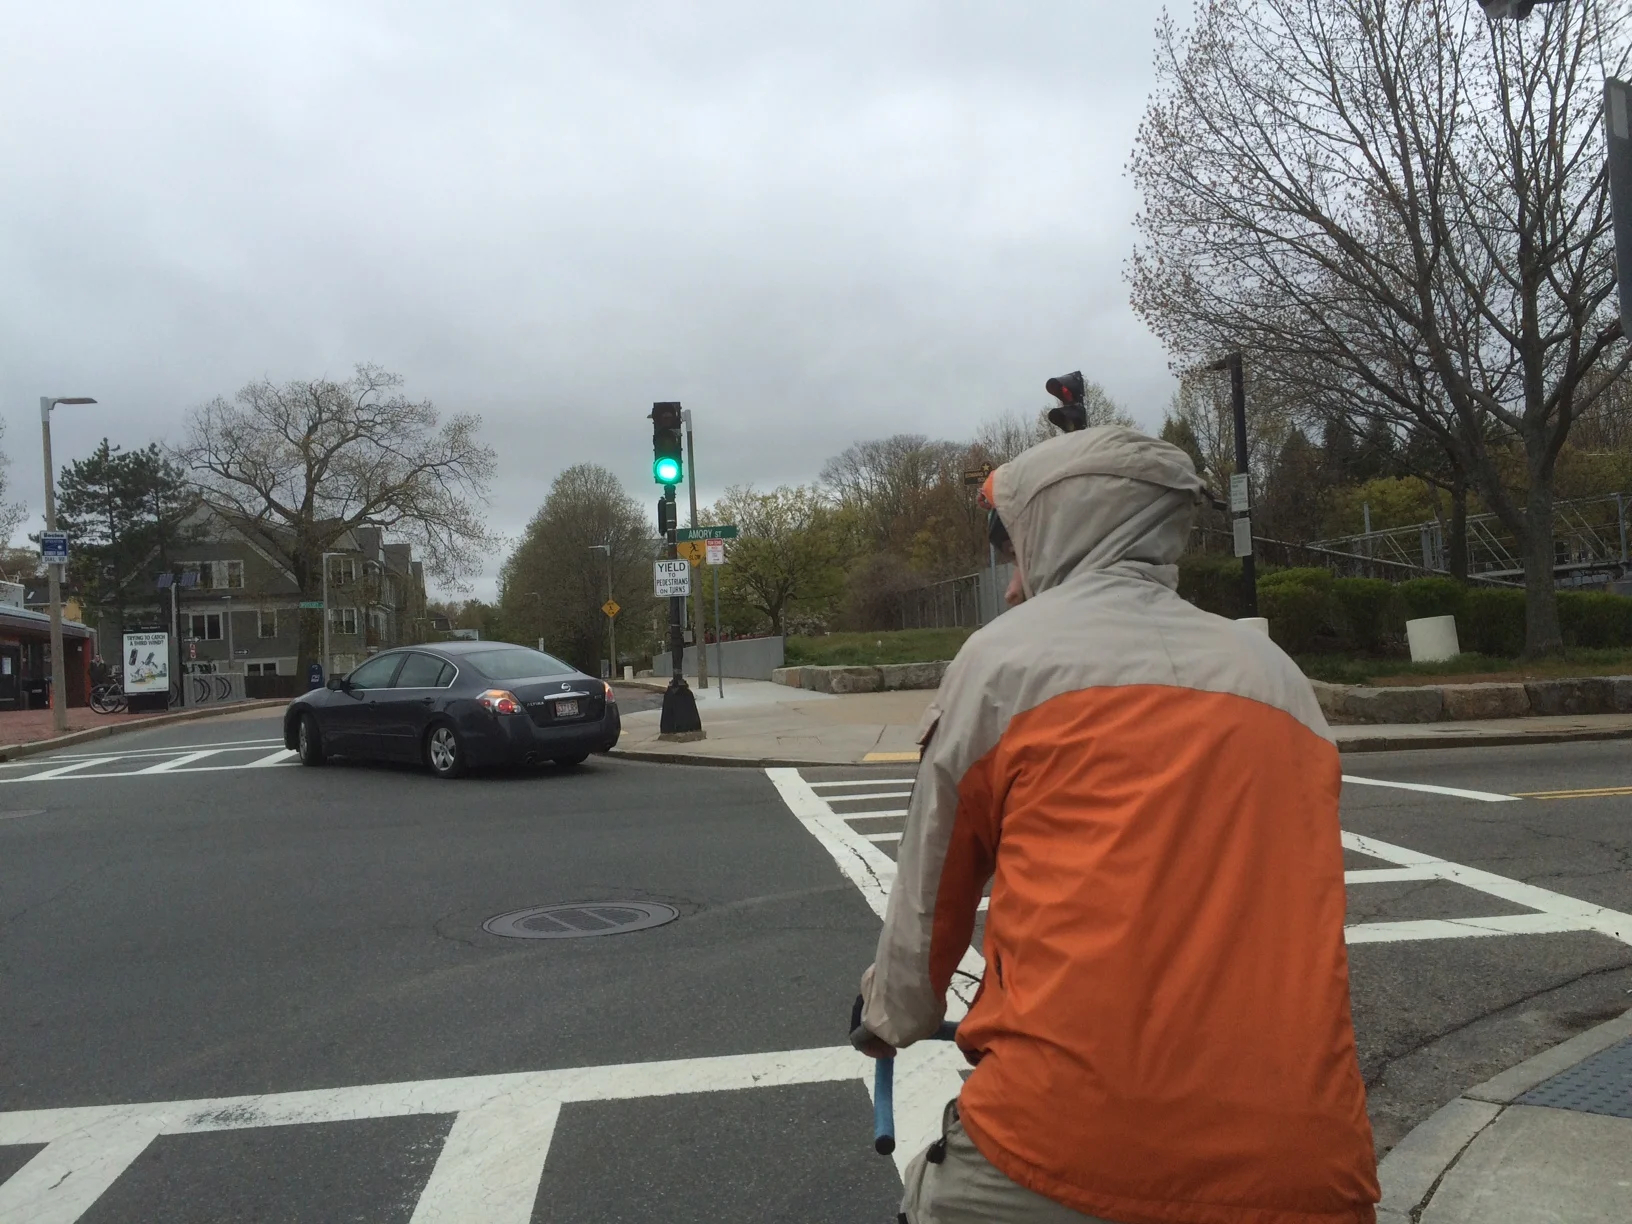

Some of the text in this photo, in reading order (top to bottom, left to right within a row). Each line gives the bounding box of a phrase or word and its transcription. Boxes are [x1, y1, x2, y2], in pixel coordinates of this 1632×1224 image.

[688, 530, 712, 539] AMORY
[658, 562, 686, 572] YIELD
[656, 578, 688, 586] PEDESTRIANS
